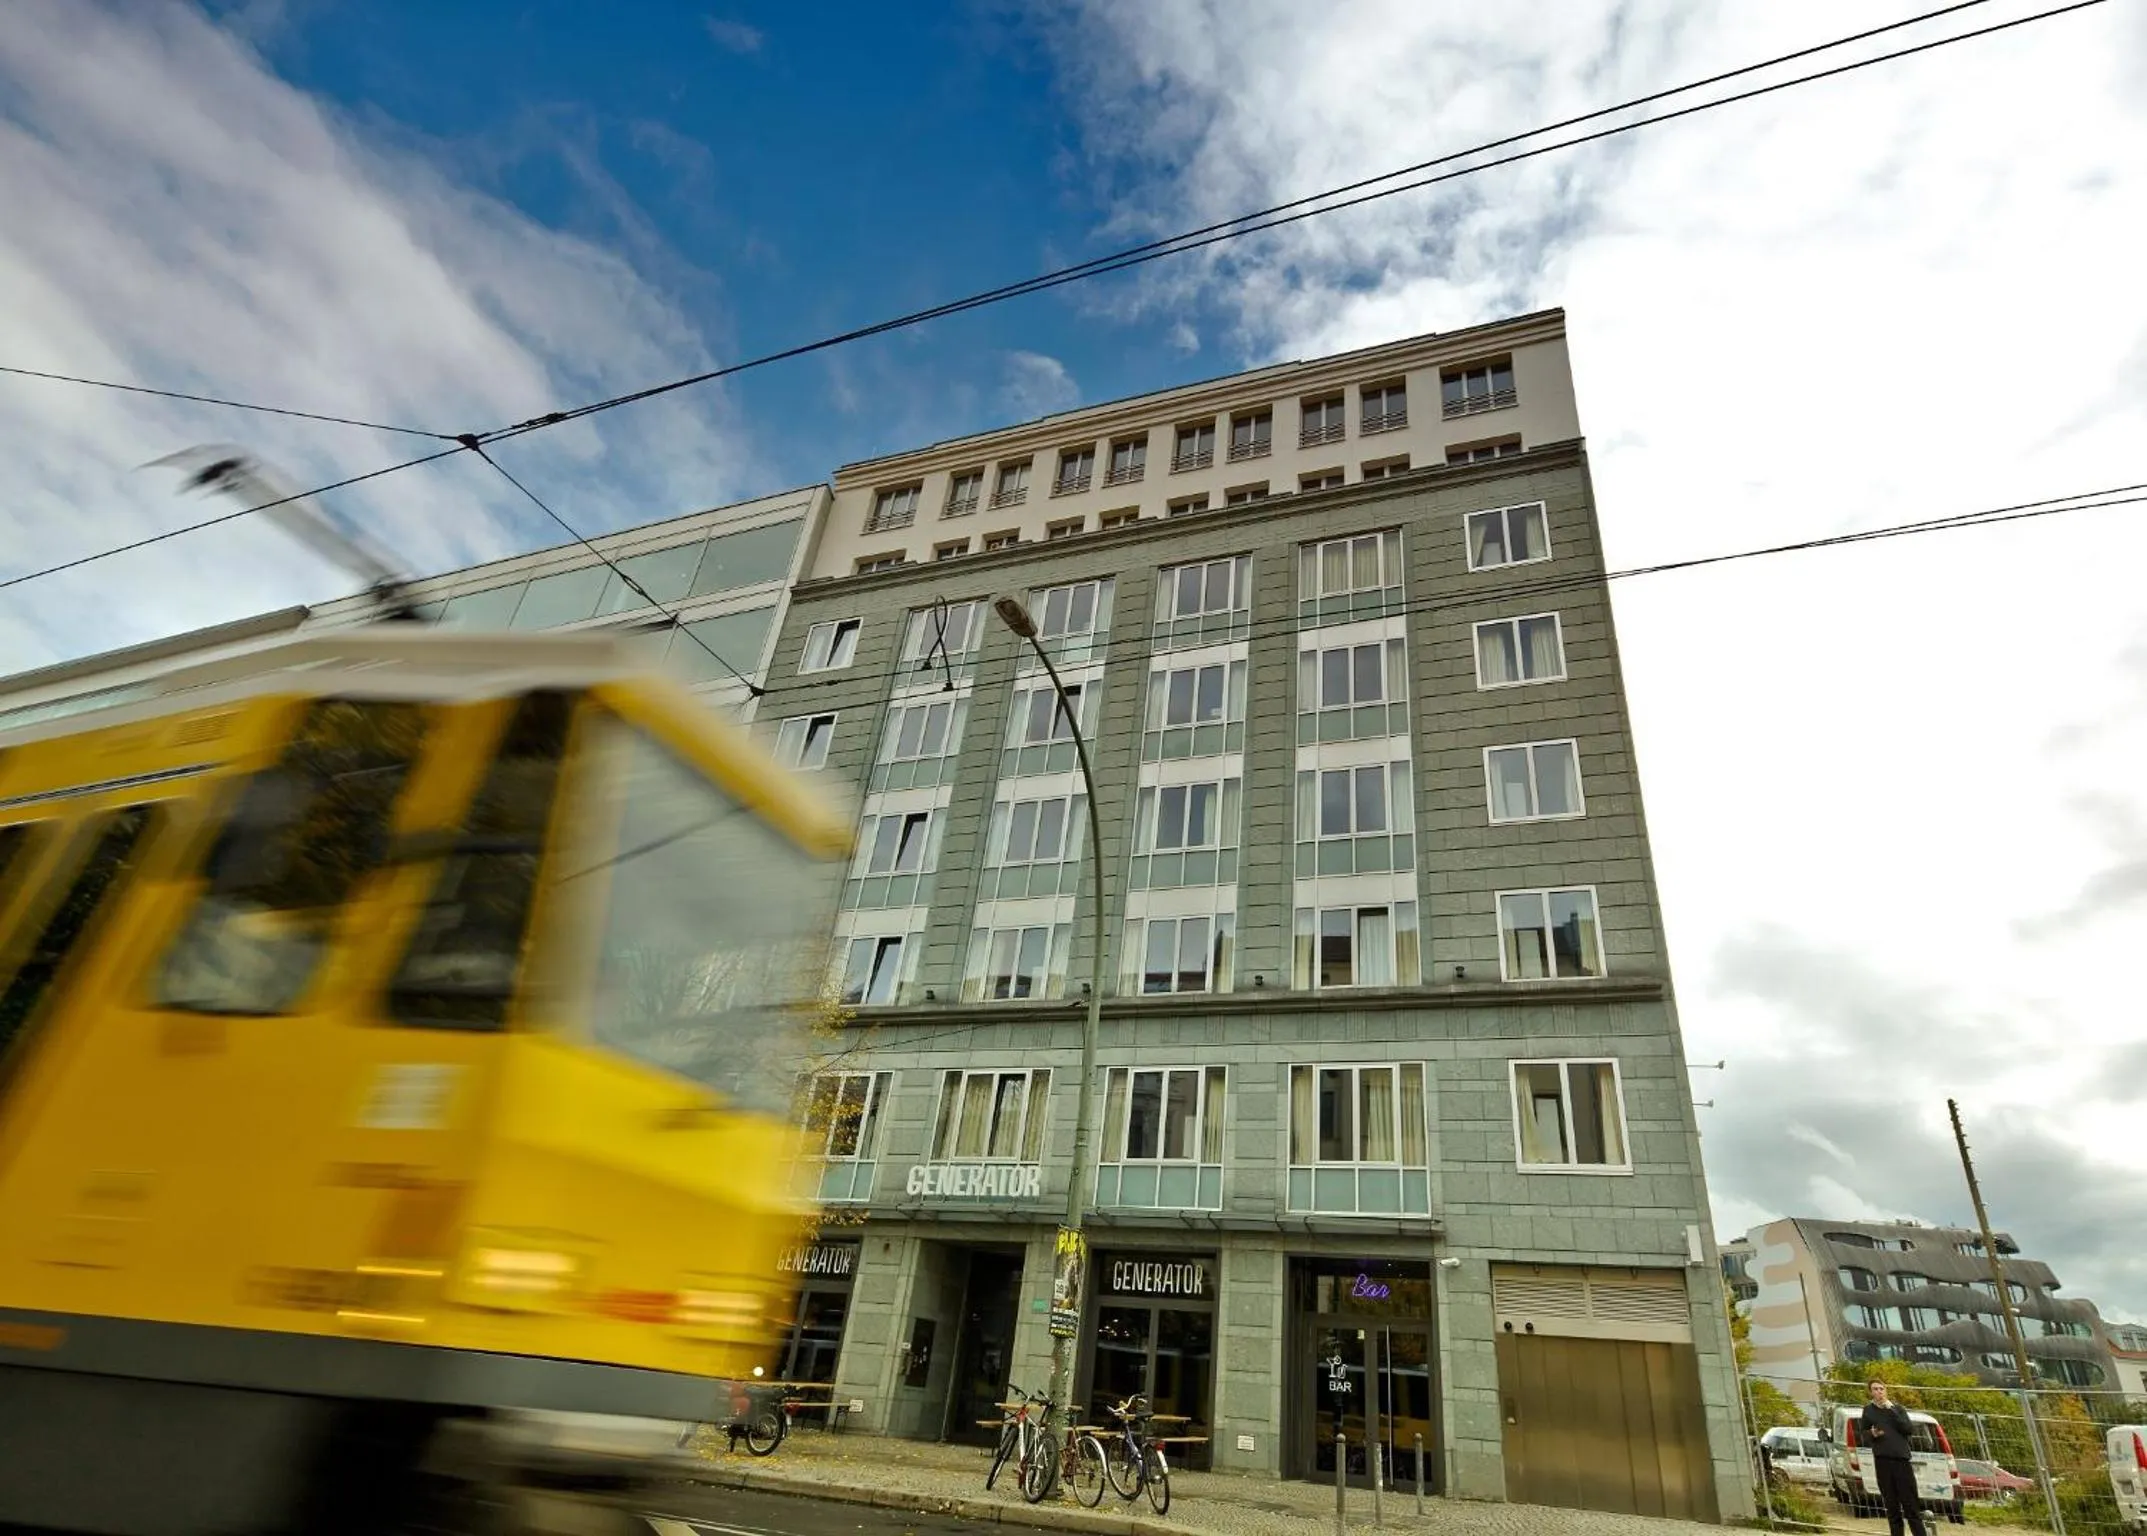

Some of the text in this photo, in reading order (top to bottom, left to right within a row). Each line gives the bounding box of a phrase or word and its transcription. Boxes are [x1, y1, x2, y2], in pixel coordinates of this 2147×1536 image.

[907, 1164, 1041, 1196] GENERATOR
[777, 1246, 851, 1273] GENERATOR
[1113, 1261, 1203, 1294] GENERATOR
[1352, 1273, 1389, 1297] Bar
[1329, 1380, 1352, 1392] BAR
